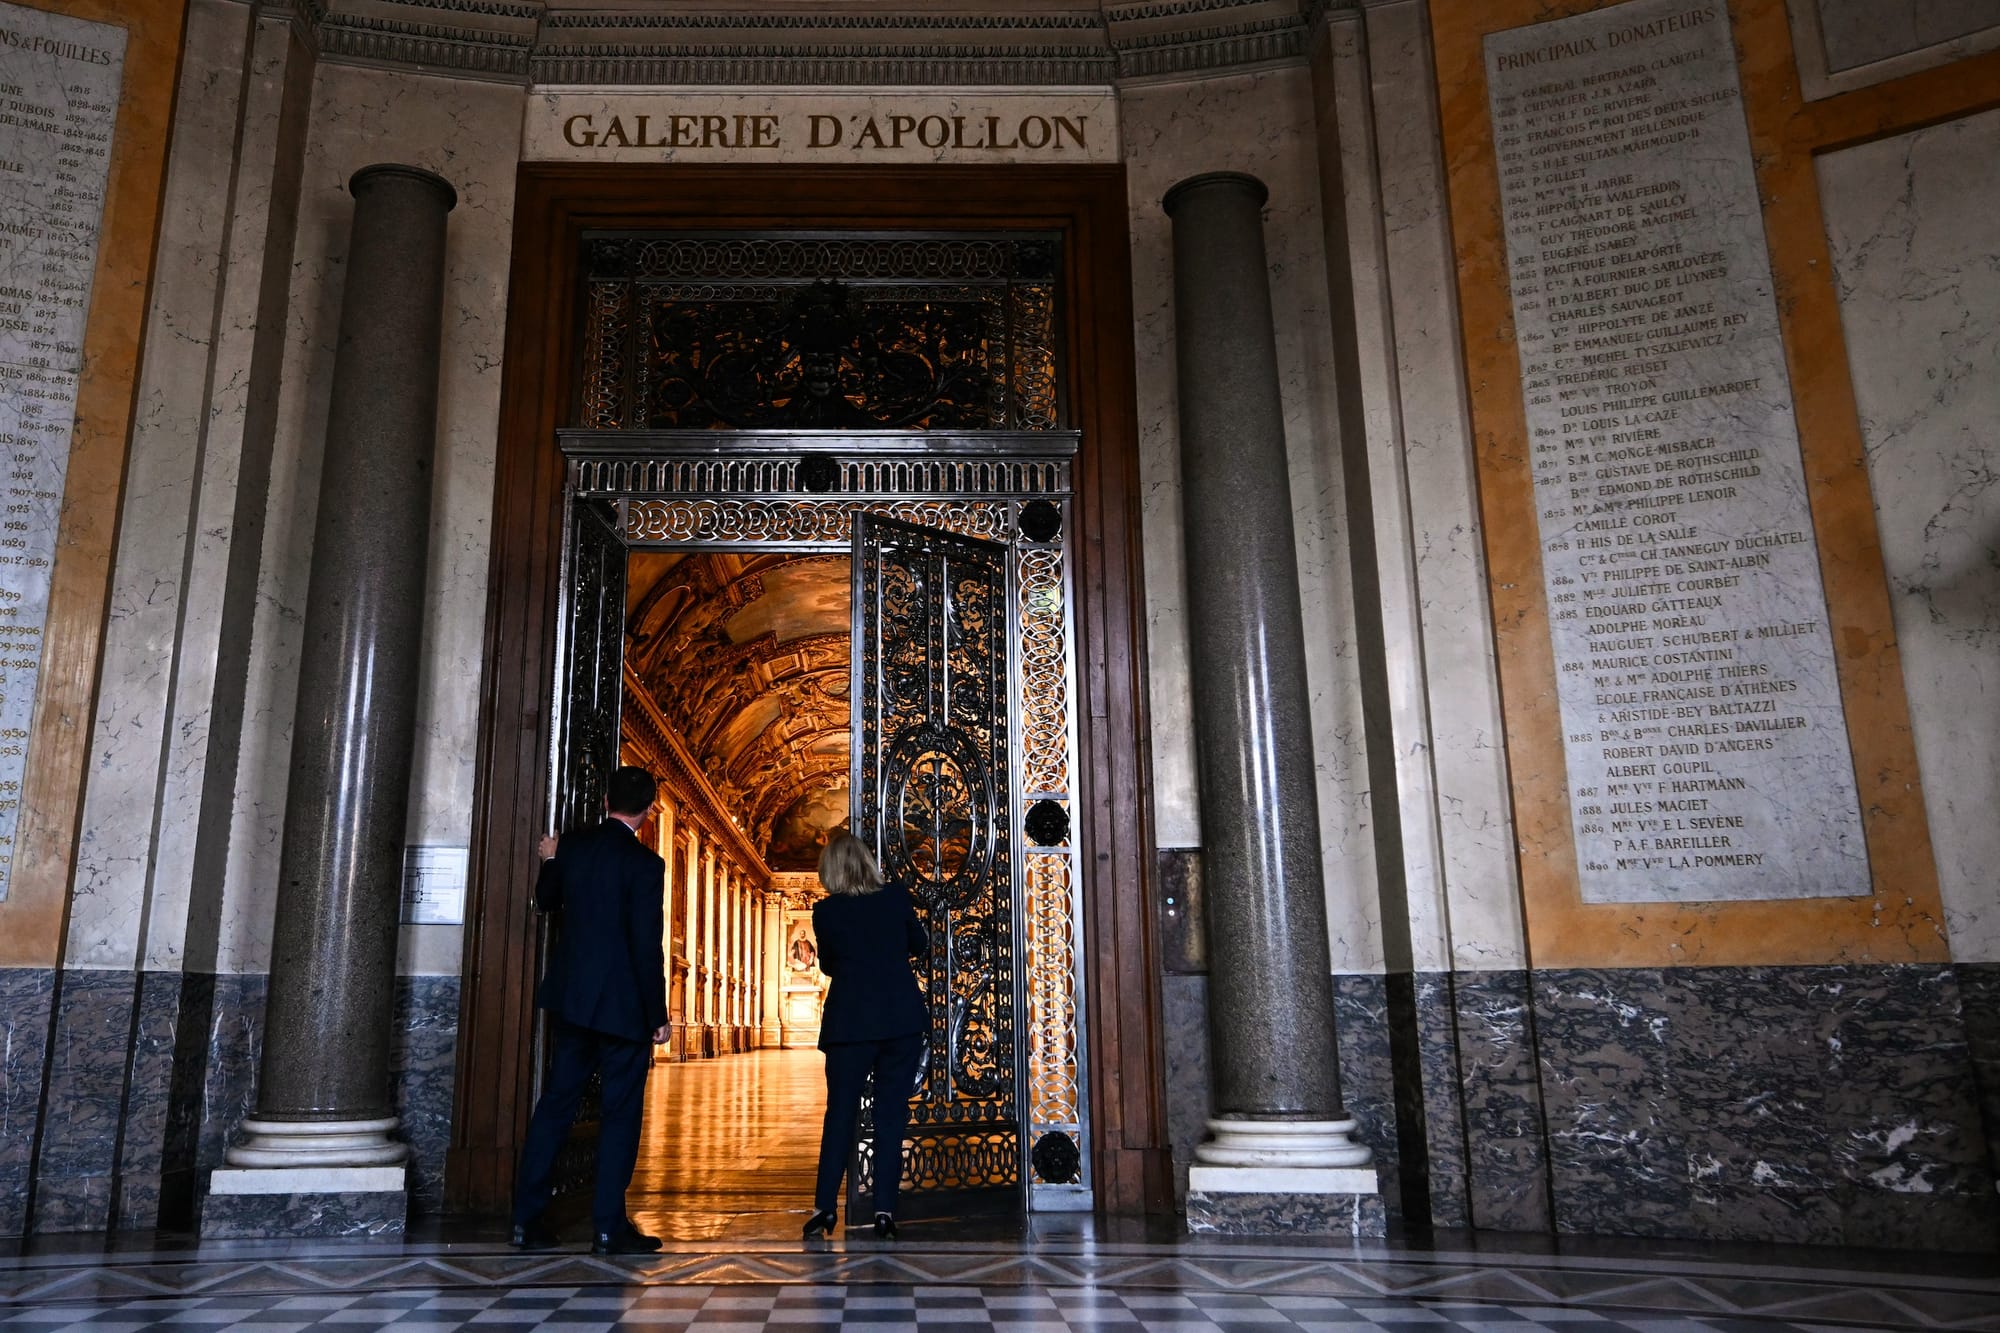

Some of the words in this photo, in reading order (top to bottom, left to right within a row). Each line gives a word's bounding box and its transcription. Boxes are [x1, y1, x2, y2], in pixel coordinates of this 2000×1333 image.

[1497, 34, 1597, 73] PRINCIPAUX
[1606, 5, 1715, 46] DONATEURS
[33, 35, 111, 67] FOUILLES
[9, 100, 55, 118] DUBOIS
[1523, 92, 1586, 114] CHEVALIER
[1583, 104, 1600, 116] DE
[0, 113, 60, 134] DELAMARE
[1603, 113, 1625, 127] ROI
[1627, 108, 1651, 122] DES
[563, 114, 781, 149] GALERIE
[807, 114, 1089, 150] D'APOLLON
[1529, 129, 1625, 157] GOUVERNEMENT
[1555, 156, 1568, 166] LE
[1573, 146, 1617, 163] SULTAN
[1545, 167, 1587, 184] GILLET
[1594, 174, 1633, 190] JARRE
[1536, 195, 1601, 216] HIPPOLYTE
[1607, 180, 1681, 202] WALFERDIN
[1550, 209, 1612, 229] CAIGNART
[1617, 205, 1633, 216] DE
[1640, 195, 1687, 212] SAULCY
[1540, 233, 1564, 246] GUY
[1642, 207, 1698, 227] MAGIMEL
[1594, 236, 1637, 252] ISABEY
[1543, 257, 1606, 277] PACIFIQUE
[1611, 243, 1682, 265] DELAPORTE
[1623, 281, 1650, 294] DUC
[1654, 277, 1672, 289] DE
[1675, 267, 1727, 285] LUYNES
[1549, 304, 1606, 323] CHARLES
[1611, 291, 1684, 313] SAUVAGEOT
[1577, 314, 1646, 334] HIPPOLYTE
[1651, 310, 1667, 322] DE
[1722, 313, 1749, 327] REY
[1582, 349, 1629, 365] MICHEL
[1623, 359, 1669, 376] REISET
[1605, 378, 1657, 394] TROYON
[1560, 403, 1598, 417] LOUIS
[1602, 394, 1657, 411] PHILIPPE
[1661, 378, 1761, 403] GUILLEMARDET
[1582, 416, 1620, 431] LOUIS
[1624, 414, 1640, 425] LA
[1595, 462, 1650, 479] GUSTAVE
[1655, 460, 1672, 471] DE
[1676, 447, 1759, 468] ROTHSCHILD
[1598, 480, 1652, 496] EDMOND
[1656, 477, 1673, 489] DE
[1677, 466, 1761, 486] ROTHSCHILD
[1627, 493, 1684, 509] PHILIPPE
[1688, 486, 1737, 502] LENOIR
[3, 519, 28, 532] 1926
[1575, 517, 1627, 533] CAMILLE
[1632, 511, 1677, 526] COROT
[1590, 536, 1611, 548] HIS
[1616, 533, 1633, 545] DE
[1638, 531, 1654, 543] LA
[1658, 526, 1697, 540] SALLE
[1662, 540, 1730, 558] TANNEGUY
[1603, 565, 1660, 581] PHILIPPE
[1664, 563, 1682, 575] DE
[1687, 554, 1769, 572] SAINT-ALBIN
[1610, 582, 1671, 598] JULIETTE
[1676, 575, 1740, 591] COURBET
[1651, 595, 1722, 611] GATTEAUX
[1587, 620, 1648, 635] ADOLPHE
[1652, 614, 1706, 629] MOREAU
[1589, 637, 1652, 653] HAUGUET
[1662, 629, 1740, 646] SCHUBERT
[1757, 622, 1817, 638] MILLIET
[1591, 655, 1648, 670] MAURICE
[1653, 648, 1732, 665] COSTANTINI
[1651, 668, 1712, 683] ADOLPHE
[1718, 663, 1768, 678] THIERS
[1609, 705, 1703, 722] ARISTIDE-BEY
[1709, 700, 1776, 715] BALTAZZI
[1667, 722, 1729, 736] CHARLES
[1734, 717, 1807, 732] DAVILLIER
[1602, 746, 1654, 759] ROBERT
[1658, 743, 1699, 756] DAVID
[1605, 764, 1657, 777] ALBERT
[1662, 760, 1713, 774] GOUPIL
[1576, 786, 1598, 797] 1887
[1672, 777, 1745, 792] HARTMANN
[1578, 803, 1601, 815] 1888
[1609, 801, 1652, 814] JULES
[1657, 798, 1708, 812] MACIET
[1654, 835, 1731, 849] BAREILLER
